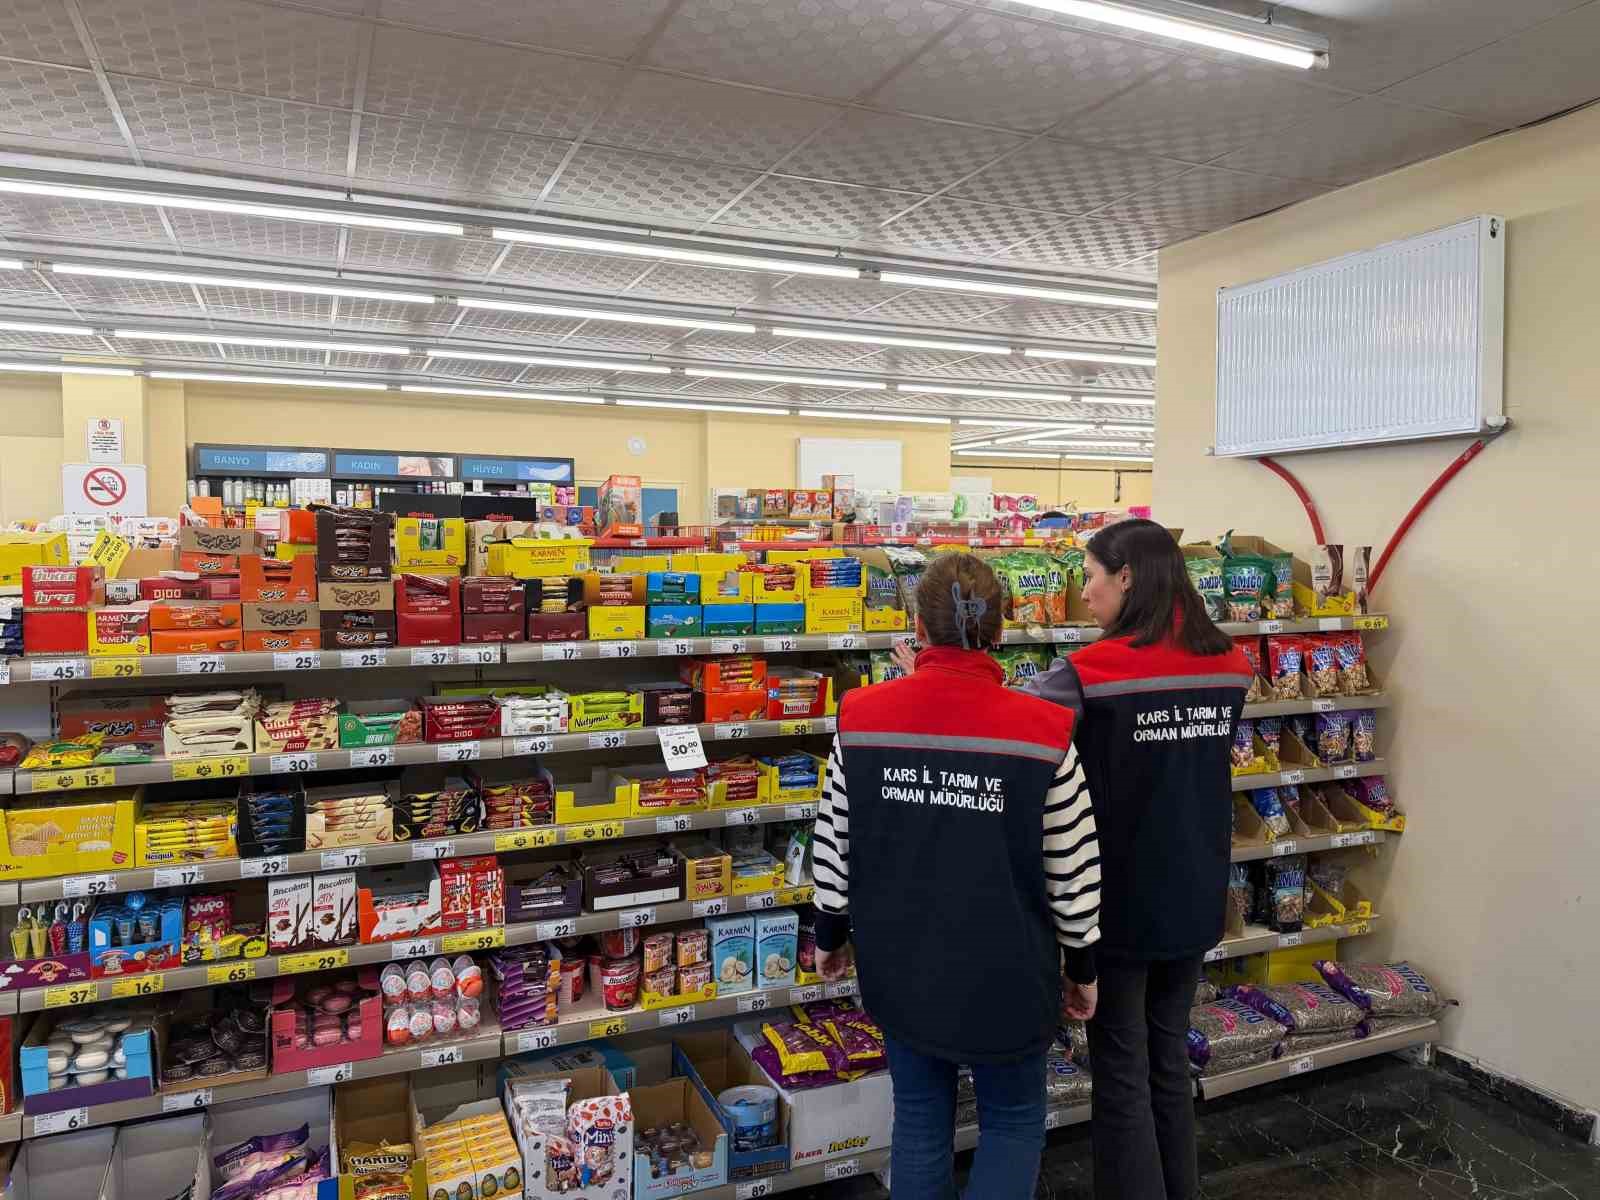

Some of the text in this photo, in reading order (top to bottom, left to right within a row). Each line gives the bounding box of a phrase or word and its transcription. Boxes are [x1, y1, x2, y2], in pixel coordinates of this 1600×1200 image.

[96, 613, 129, 623] ARMEN
[96, 634, 129, 644] ARMEN
[842, 638, 854, 649] 27
[617, 646, 630, 658] 19
[675, 643, 687, 655] 15
[732, 644, 740, 655] 9
[780, 640, 792, 652] 12
[431, 652, 447, 664] 37
[477, 651, 492, 663] 10
[563, 647, 575, 660] 17
[295, 656, 313, 669] 25
[360, 654, 378, 666] 25
[115, 664, 135, 677] 29
[199, 660, 217, 673] 27
[53, 666, 75, 680] 45
[1136, 704, 1232, 726] KARS İL TARIM VE
[731, 727, 744, 738] 27
[793, 723, 807, 735] 58
[1133, 727, 1178, 742] ORMAN
[530, 741, 547, 753] 49
[604, 736, 620, 748] 39
[457, 749, 473, 760] 27
[671, 744, 689, 756] 30
[368, 753, 387, 765] 49
[221, 764, 235, 775] 19
[289, 759, 309, 772] 30
[84, 775, 98, 787] 15
[883, 765, 1002, 792] KARS İL TARIM VE
[881, 786, 1004, 813] ORMAN MÜDÜRLÜĞÜ
[742, 812, 754, 823] 16
[674, 819, 686, 830] 18
[600, 826, 613, 838] 10
[533, 834, 545, 846] 14
[434, 846, 446, 858] 17
[345, 855, 358, 867] 17
[262, 862, 280, 874] 29
[182, 871, 196, 884] 17
[87, 880, 107, 894] 52
[760, 896, 774, 907] 10
[706, 904, 721, 915] 49
[634, 914, 649, 926] 39
[554, 925, 569, 937] 22
[477, 936, 494, 948] 59
[408, 944, 427, 956] 44
[318, 957, 336, 969] 29
[228, 968, 247, 981] 65
[136, 981, 153, 995] 16
[70, 990, 89, 1004] 37
[751, 999, 766, 1010] 89
[676, 1011, 689, 1024] 19
[606, 1023, 621, 1036] 65
[535, 1035, 550, 1048] 10
[437, 1053, 455, 1065] 44
[334, 1070, 344, 1082] 6
[193, 1094, 203, 1107] 6
[67, 1115, 79, 1129] 6
[835, 1165, 853, 1176] 100
[751, 1185, 767, 1197] 89
